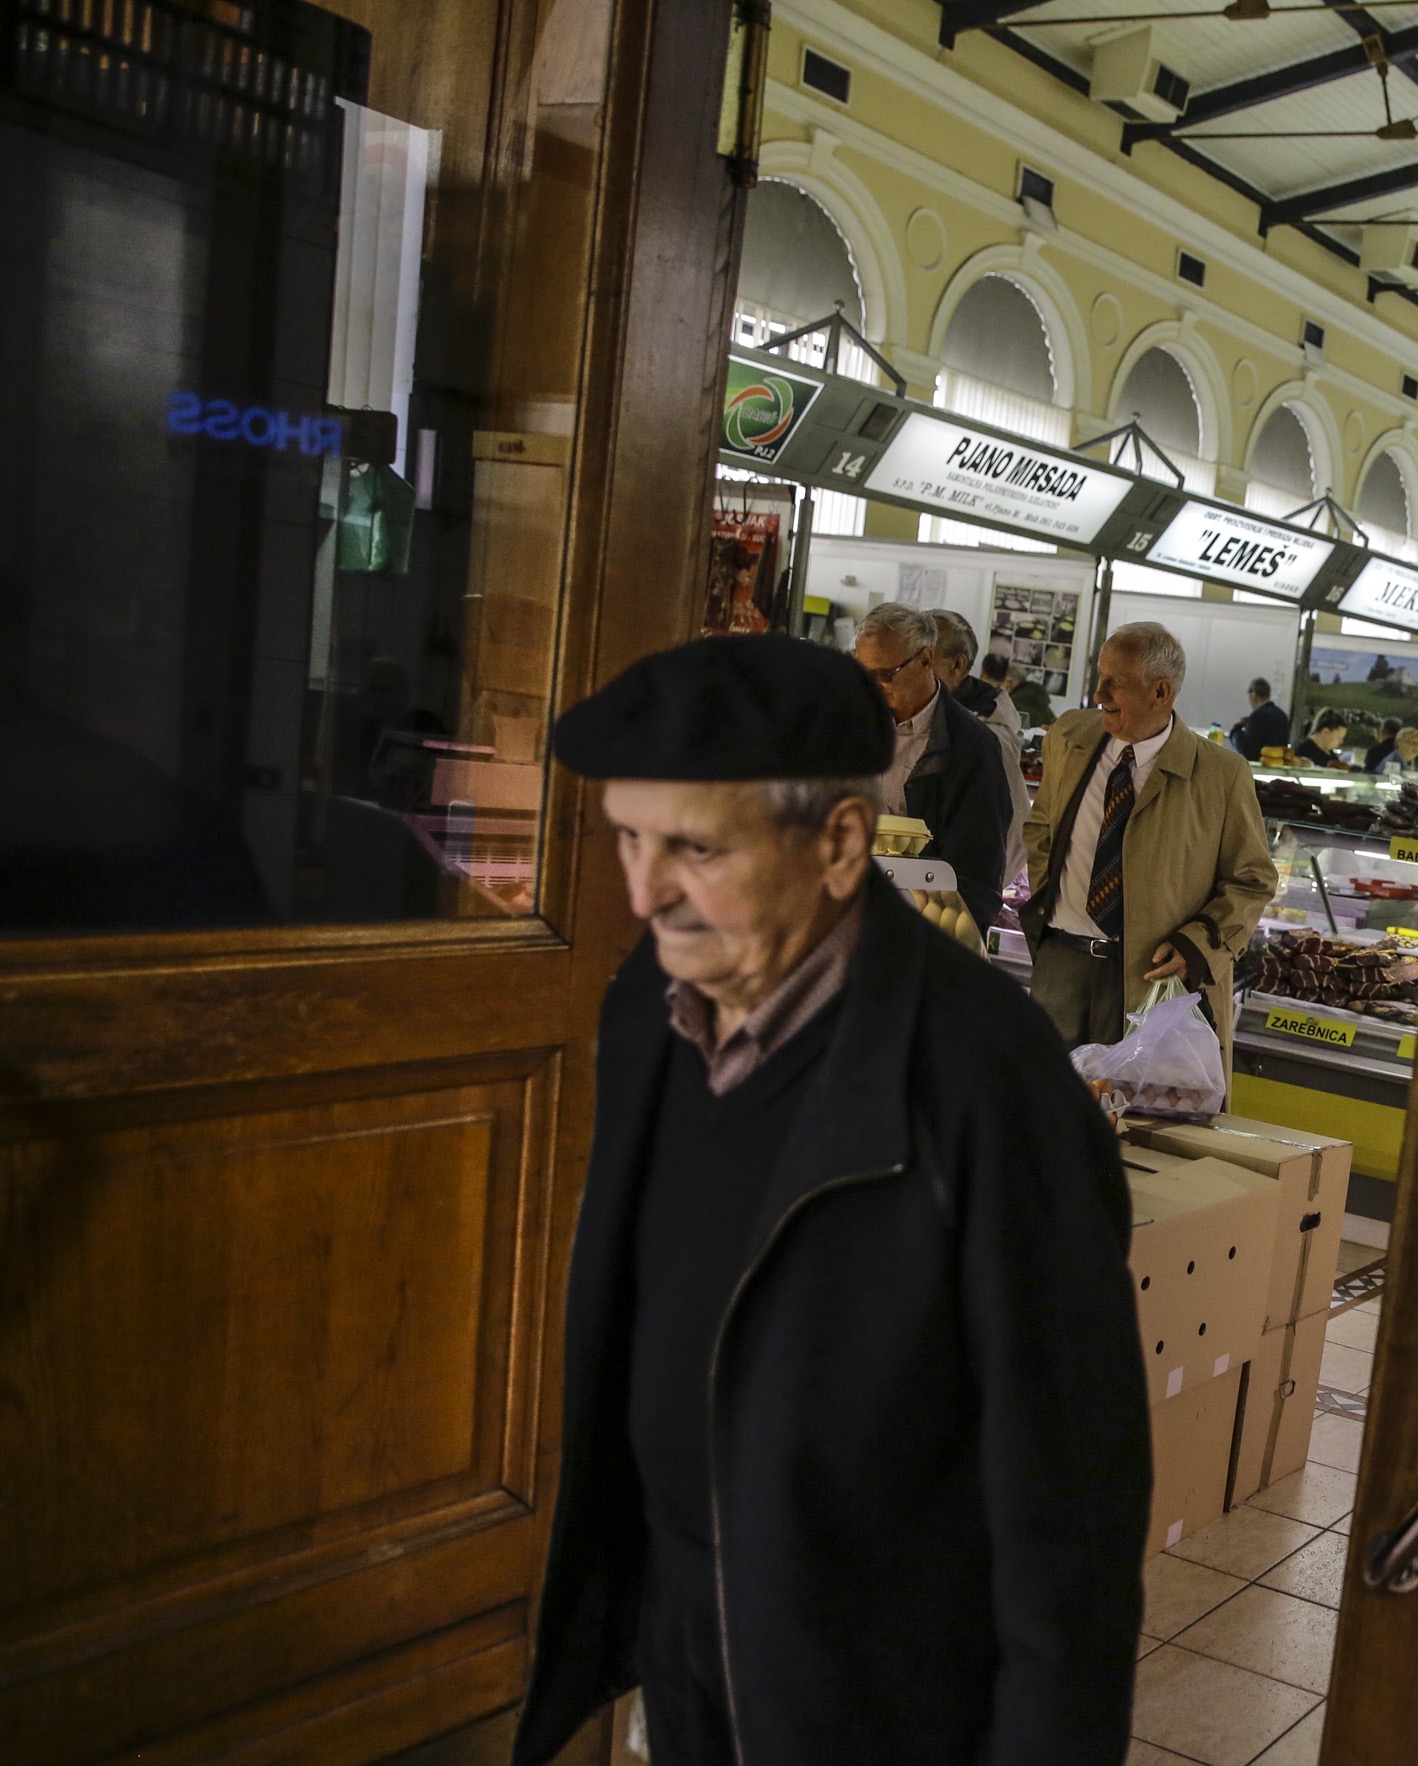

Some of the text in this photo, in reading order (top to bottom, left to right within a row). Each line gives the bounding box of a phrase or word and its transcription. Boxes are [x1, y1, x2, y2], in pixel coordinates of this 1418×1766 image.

[832, 451, 866, 478] 14
[946, 437, 1014, 478] PJANO
[1006, 456, 1088, 501] MIRSADA
[1126, 531, 1153, 552] 15
[1198, 529, 1298, 578] "LEMEŠ"
[1271, 1016, 1347, 1044] ZAREBNICA
